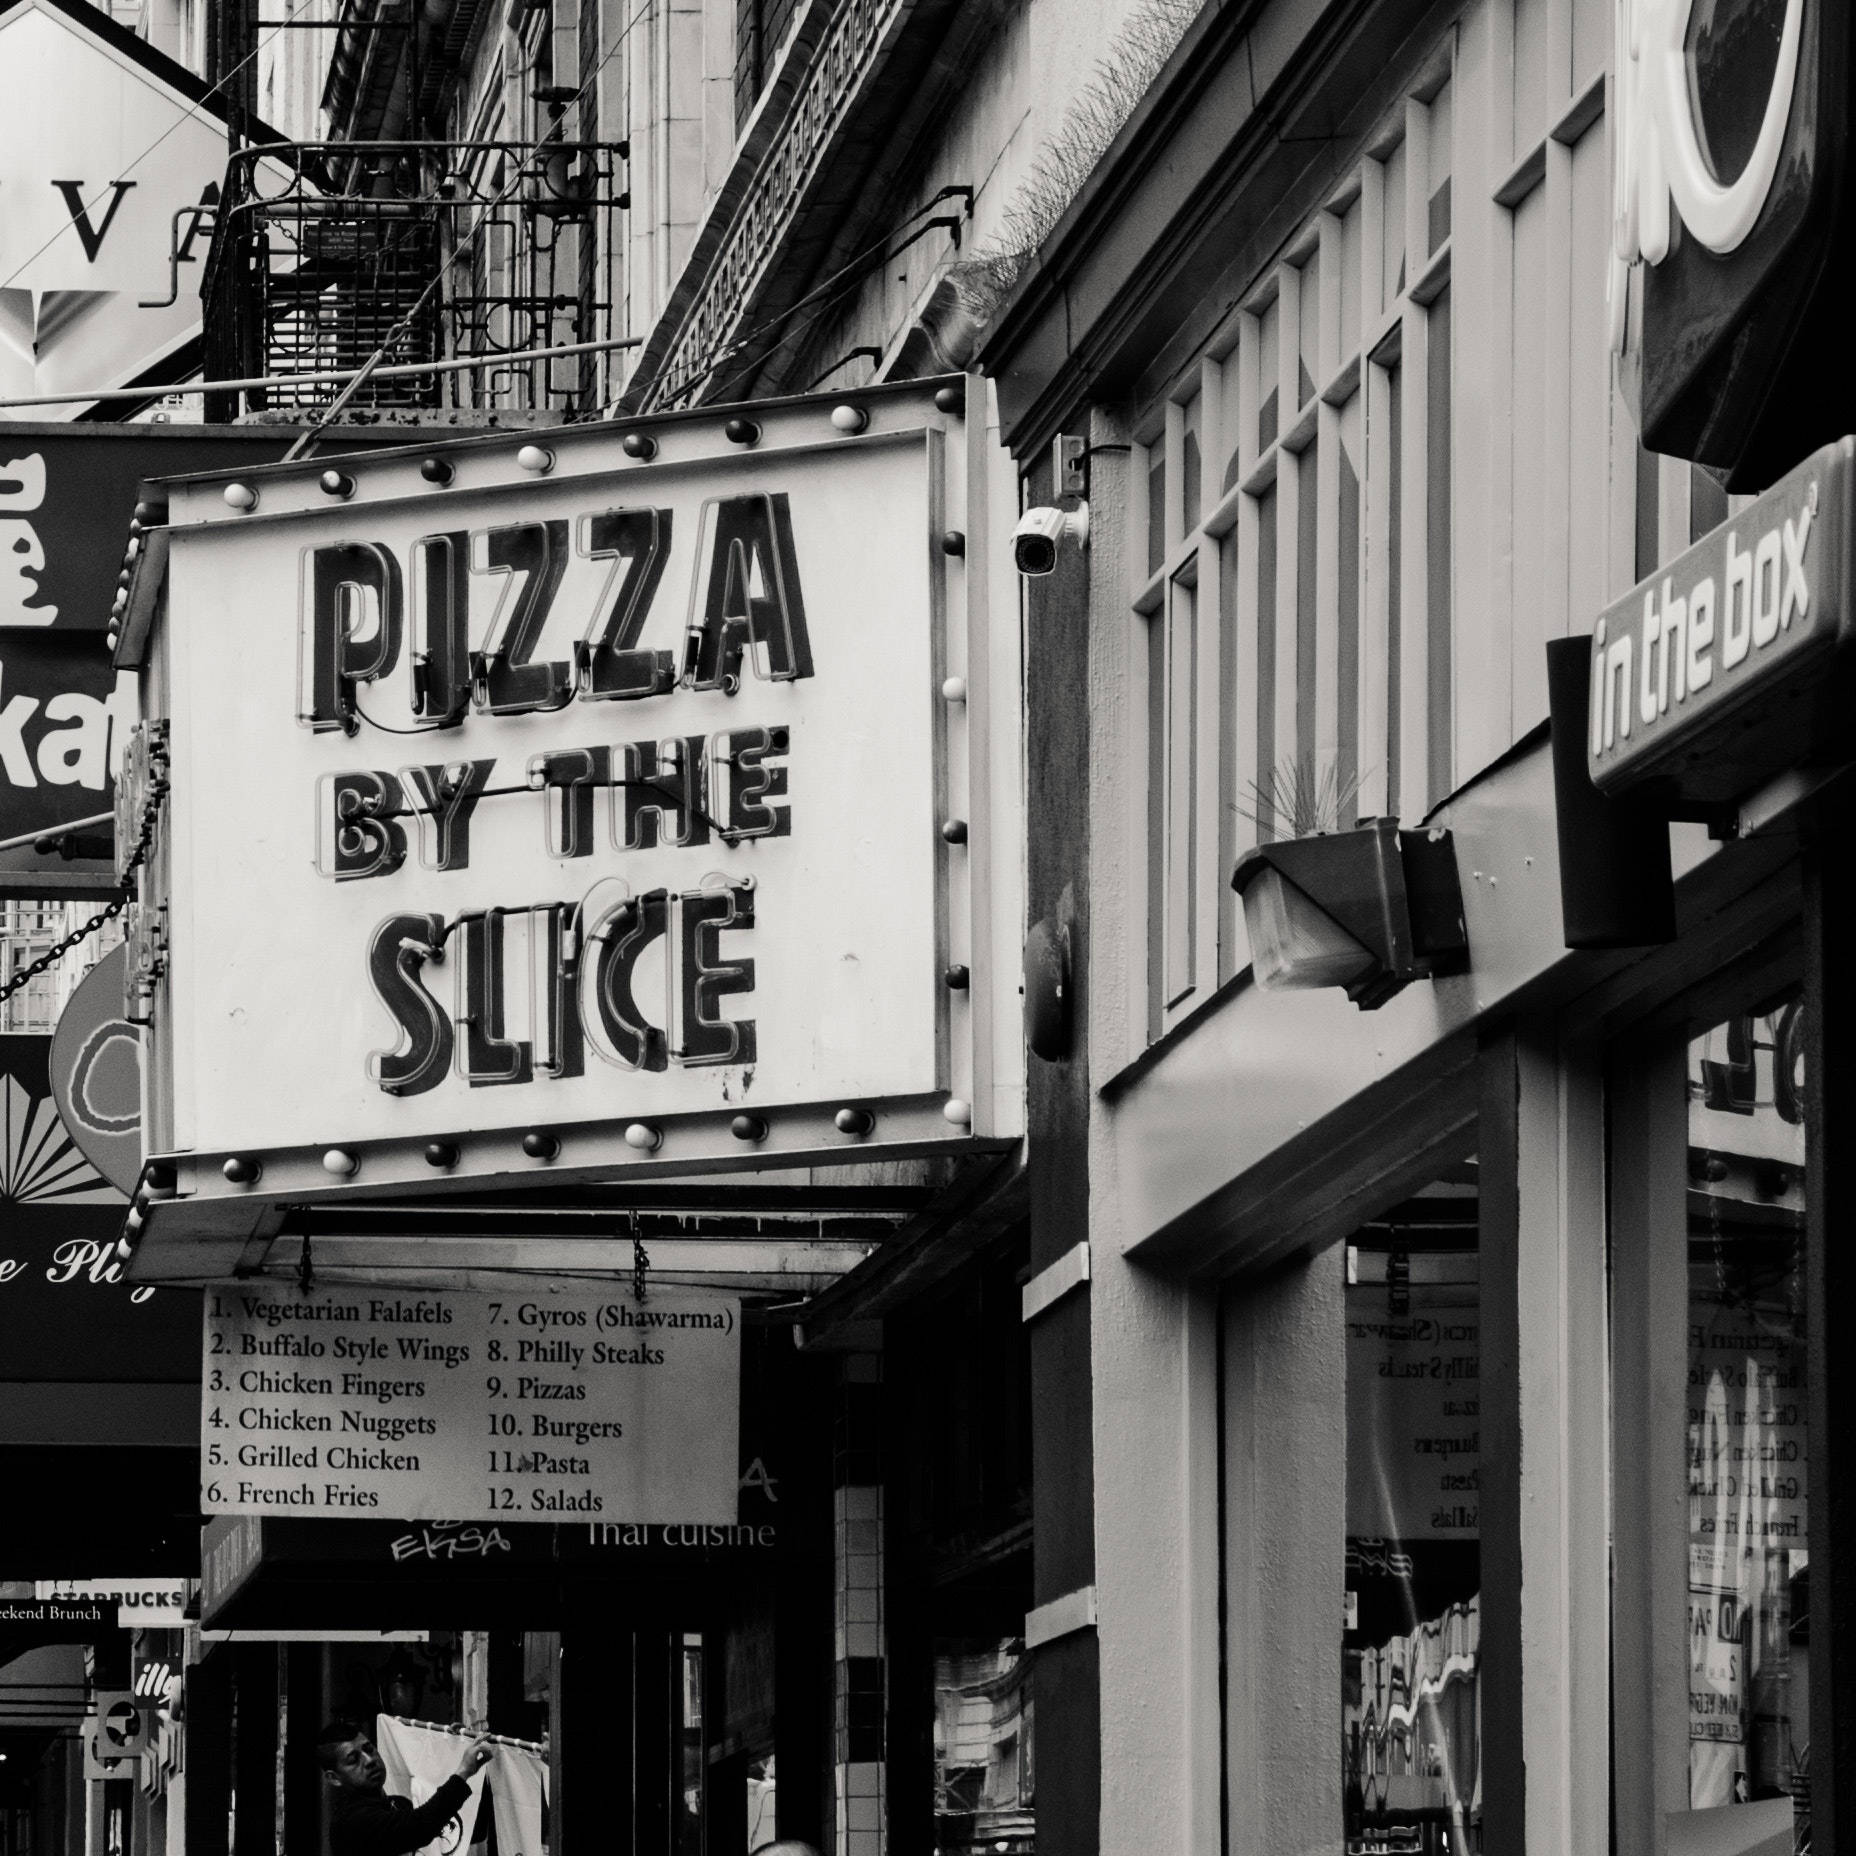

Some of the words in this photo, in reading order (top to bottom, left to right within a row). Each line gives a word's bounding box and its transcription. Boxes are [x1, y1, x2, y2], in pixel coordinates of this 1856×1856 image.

[296, 491, 814, 735] PIZZA
[1593, 617, 1632, 757] in
[1640, 575, 1715, 724] the
[1723, 505, 1811, 672] box
[315, 758, 498, 883] BY
[527, 724, 792, 860] THE
[364, 886, 760, 1097] SLICE
[209, 1297, 233, 1320] 1.
[242, 1297, 360, 1327] Vegetarian
[368, 1300, 454, 1325] Falafels
[488, 1303, 510, 1327] 7.
[518, 1305, 587, 1334] Gyros
[595, 1306, 735, 1335] (Shawarma)
[209, 1334, 232, 1357] 2.
[241, 1334, 325, 1359] Buffalo
[333, 1335, 389, 1363] Style
[396, 1338, 470, 1365] Wings
[487, 1341, 510, 1364] 8.
[518, 1341, 584, 1370] Philly
[592, 1342, 665, 1366] Steaks
[208, 1370, 231, 1393] 3.
[239, 1370, 333, 1396] Chicken
[341, 1372, 426, 1403] Fingers
[486, 1377, 510, 1400] 9.
[518, 1377, 587, 1402] Pizzas
[208, 1407, 231, 1430] 4.
[238, 1407, 333, 1433] Chicken
[340, 1410, 437, 1440] Nuggets
[487, 1413, 525, 1437] 10.
[532, 1414, 623, 1444] Burgers
[207, 1445, 230, 1468] 5.
[237, 1445, 318, 1471] Grilled
[326, 1447, 421, 1473] Chicken
[532, 1452, 590, 1476] Pasta
[207, 1482, 229, 1504] 6.
[237, 1482, 315, 1507] French
[323, 1484, 379, 1509] Fries
[487, 1488, 525, 1512] 12.
[531, 1489, 604, 1514] Salads
[662, 1522, 778, 1548] cuisine
[49, 1606, 101, 1620] Brunch
